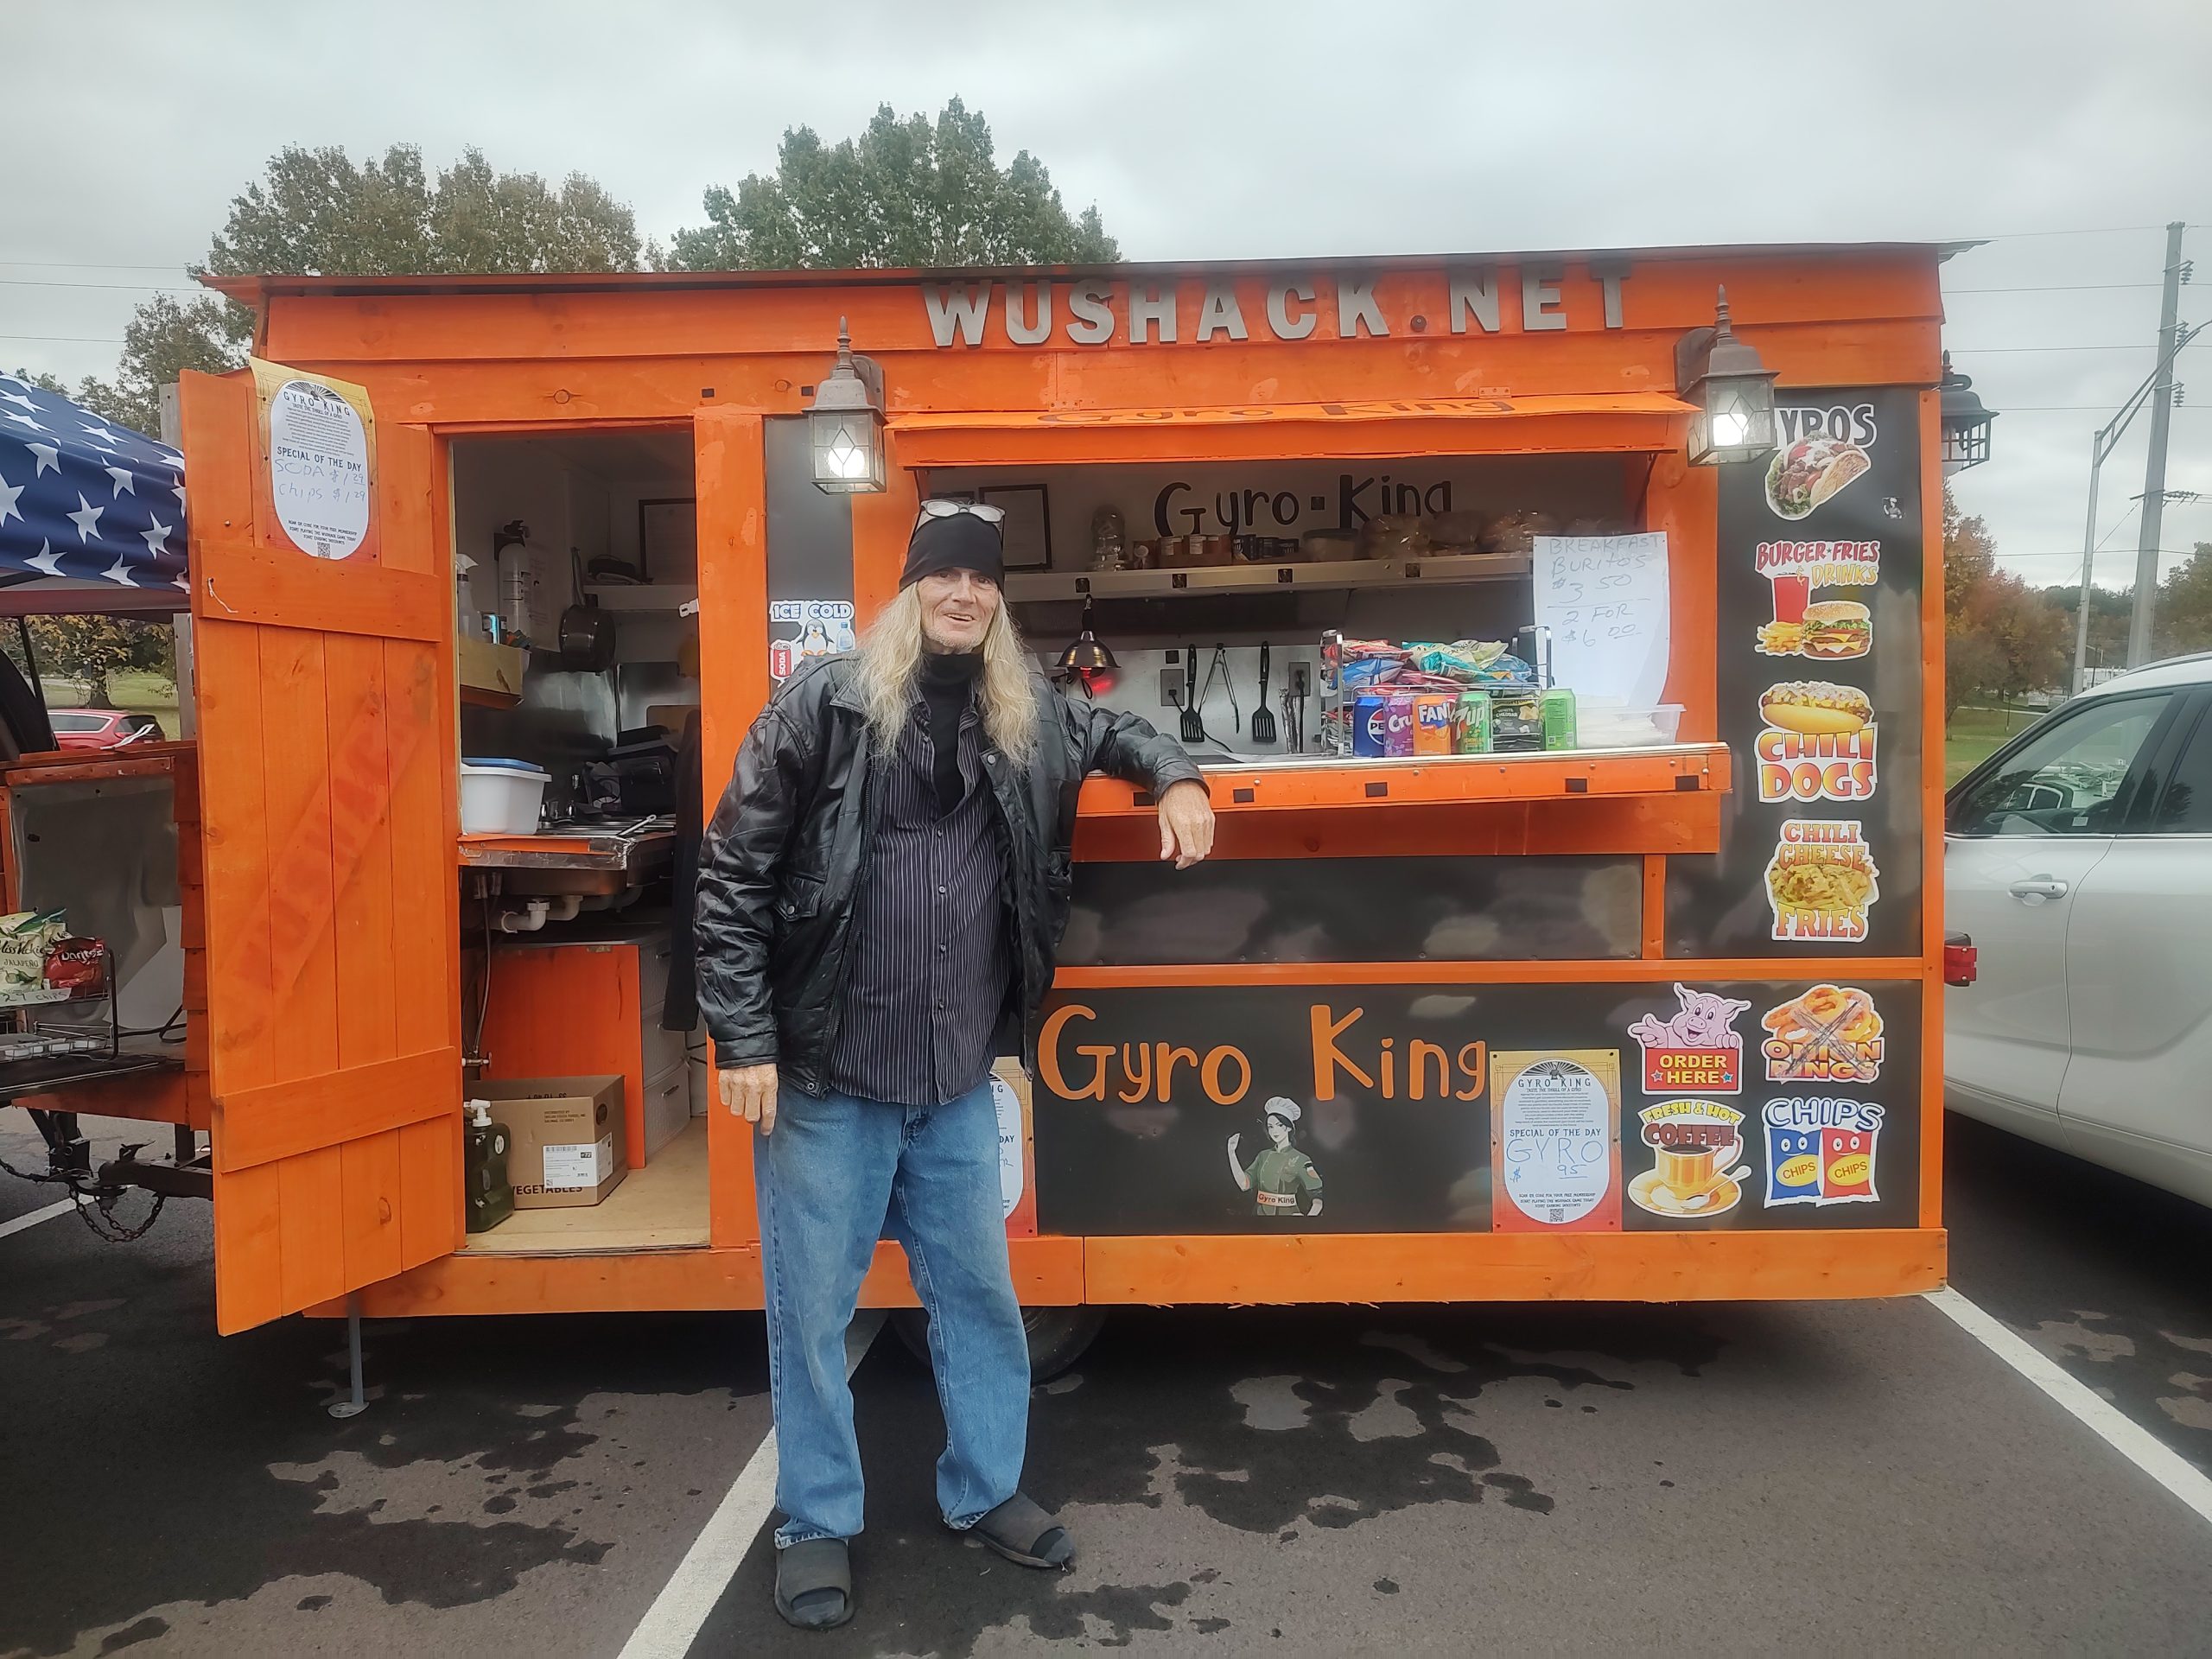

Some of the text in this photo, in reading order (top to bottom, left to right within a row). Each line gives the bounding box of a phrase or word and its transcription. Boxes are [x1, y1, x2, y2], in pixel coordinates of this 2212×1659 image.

[283, 391, 350, 416] GYRO KING
[1037, 398, 1516, 423] Gyro King
[1779, 405, 1874, 448] YROS
[275, 459, 324, 477] SODA
[277, 446, 361, 472] SPECIAL OF THE DAY
[1154, 481, 1300, 536] Gyro
[1550, 535, 1662, 554] BREAKFAST
[1757, 541, 1880, 571] BURGER FRIES
[1812, 563, 1878, 587] DRINKS
[773, 604, 852, 619] ICE COLD
[1562, 611, 1579, 625] 2
[1758, 728, 1875, 761] CHILI
[1761, 761, 1873, 798] DOGS
[1784, 823, 1858, 843] CHILI
[1778, 844, 1866, 871] CHEESE
[1776, 901, 1866, 938] FRIES
[1038, 1003, 1487, 1105] Gyro King
[1660, 1054, 1727, 1069] ORDER
[1518, 1077, 1591, 1087] GYRO KING
[1667, 1071, 1719, 1084] HERE
[1643, 1102, 1741, 1125] FRESH & HOT
[1765, 1099, 1883, 1131] CHIPS
[1510, 1128, 1544, 1138] SPECIAL
[1644, 1123, 1735, 1146] COFFEE
[1506, 1137, 1603, 1163] GYRO
[1783, 1162, 1816, 1179] CHIPS
[1834, 1161, 1867, 1179] CHIPS
[512, 1184, 582, 1195] EGETABLES
[1258, 1193, 1276, 1203] Gyro
